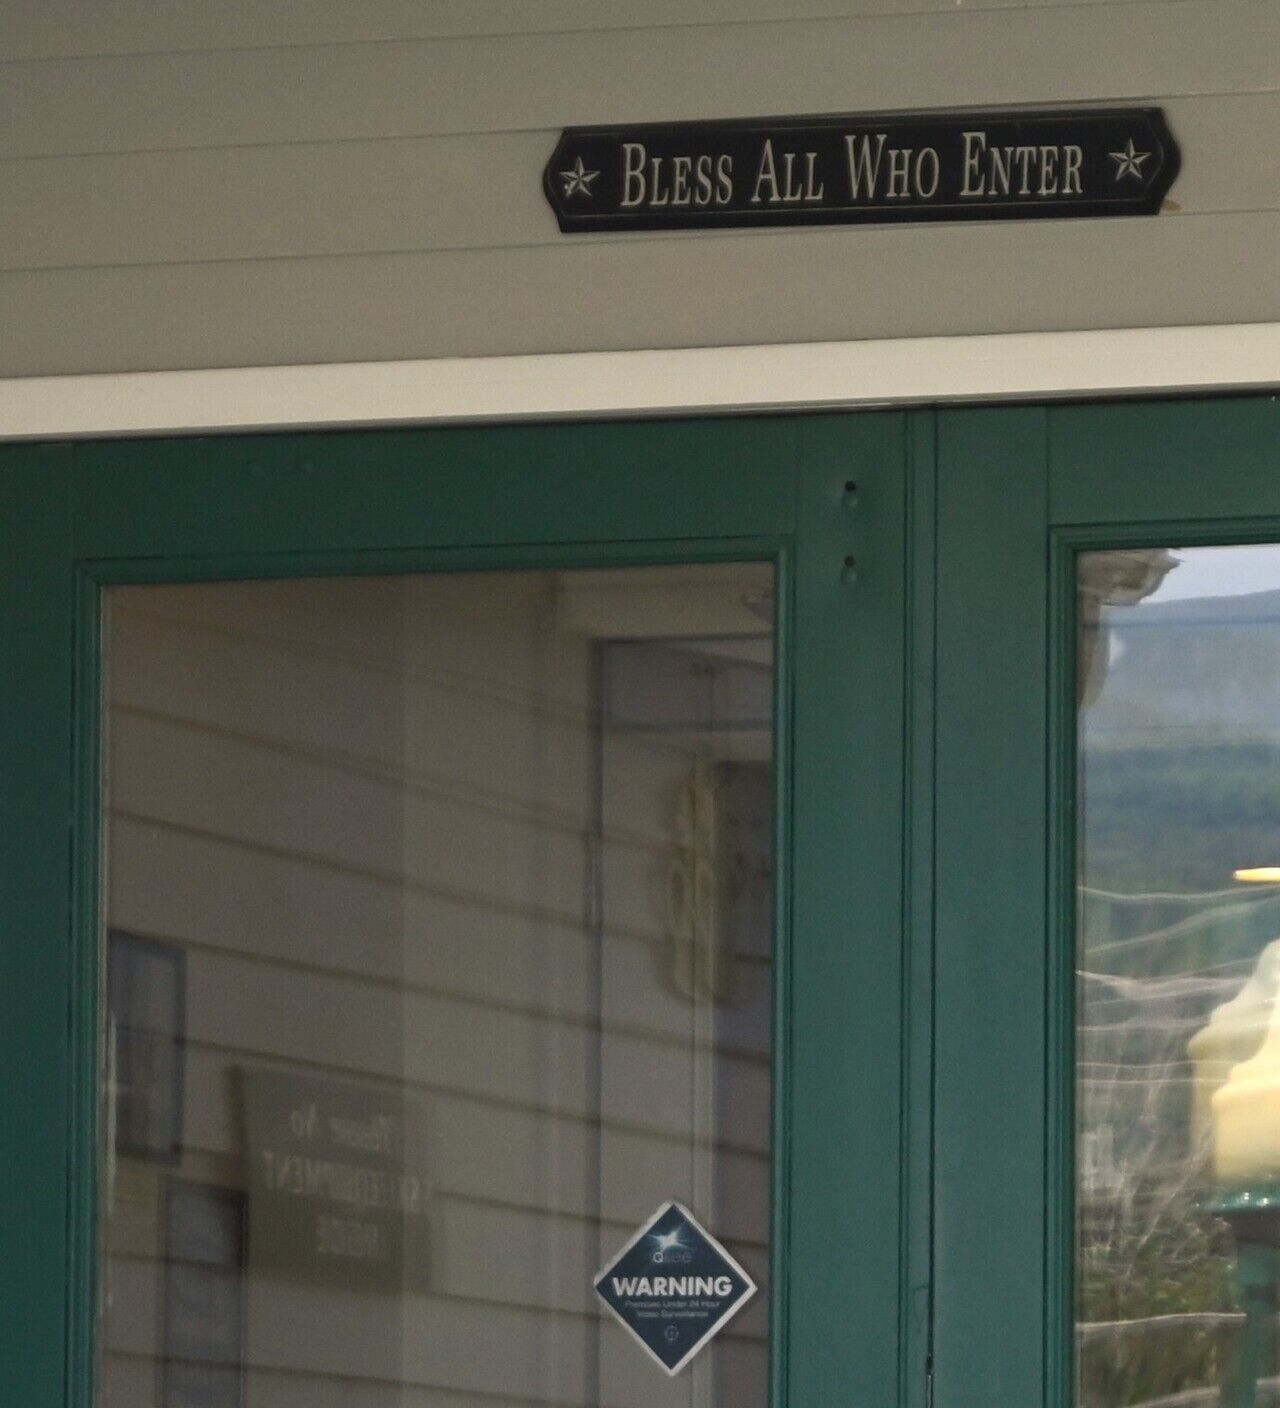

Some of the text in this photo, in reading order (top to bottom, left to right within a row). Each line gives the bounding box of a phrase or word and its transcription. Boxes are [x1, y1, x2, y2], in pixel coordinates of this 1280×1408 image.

[620, 131, 1084, 206] BLESS ALL WHO ENTER
[612, 1275, 733, 1297] WARNING
